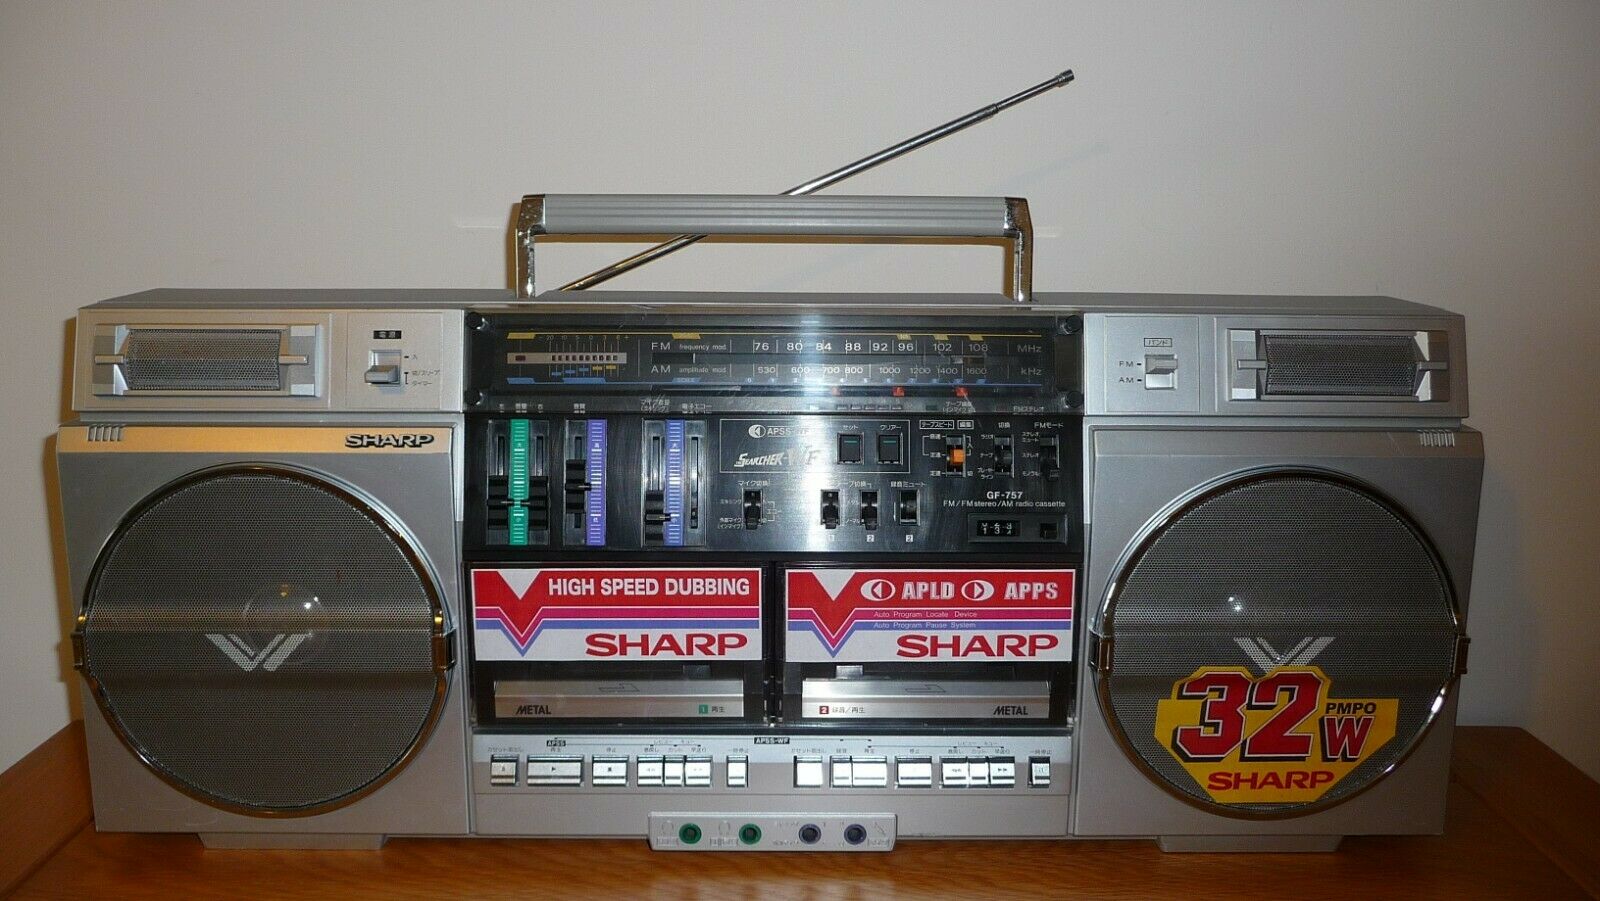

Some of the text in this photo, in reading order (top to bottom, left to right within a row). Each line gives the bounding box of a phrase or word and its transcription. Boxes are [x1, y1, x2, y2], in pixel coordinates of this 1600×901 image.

[651, 342, 671, 351] FM
[679, 343, 709, 352] frequency
[754, 342, 770, 351] 76
[786, 342, 803, 351] 80
[815, 342, 832, 352] 84
[845, 342, 861, 352] 88
[872, 342, 888, 352] 92
[898, 343, 914, 352] 96
[933, 343, 952, 352] 102
[968, 344, 989, 353] 108
[1017, 345, 1042, 354] MHz
[651, 365, 671, 374] AM
[757, 366, 776, 374] 530
[791, 366, 810, 374] 600
[822, 366, 840, 374] 700
[844, 366, 864, 374] 800
[879, 367, 901, 375] 1000
[910, 367, 931, 375] 1200
[936, 367, 959, 375] 1400
[966, 367, 988, 376] 1600
[1021, 367, 1042, 377] kHz
[345, 434, 435, 448] SHARP
[986, 491, 1023, 500] GF-757
[548, 578, 750, 596] HIGH SPEED DUBBING
[902, 582, 1059, 600] APLD APPS
[893, 611, 923, 619] Program
[893, 622, 923, 630] Program
[950, 622, 976, 630] System
[585, 633, 748, 657] SHARP
[896, 634, 1059, 658] SHARP
[515, 705, 551, 715] METAL
[993, 706, 1029, 716] METAL
[1325, 702, 1377, 715] PMPO
[1171, 671, 1324, 763] 32
[1319, 715, 1377, 763] W
[1207, 771, 1336, 791] SHARP
